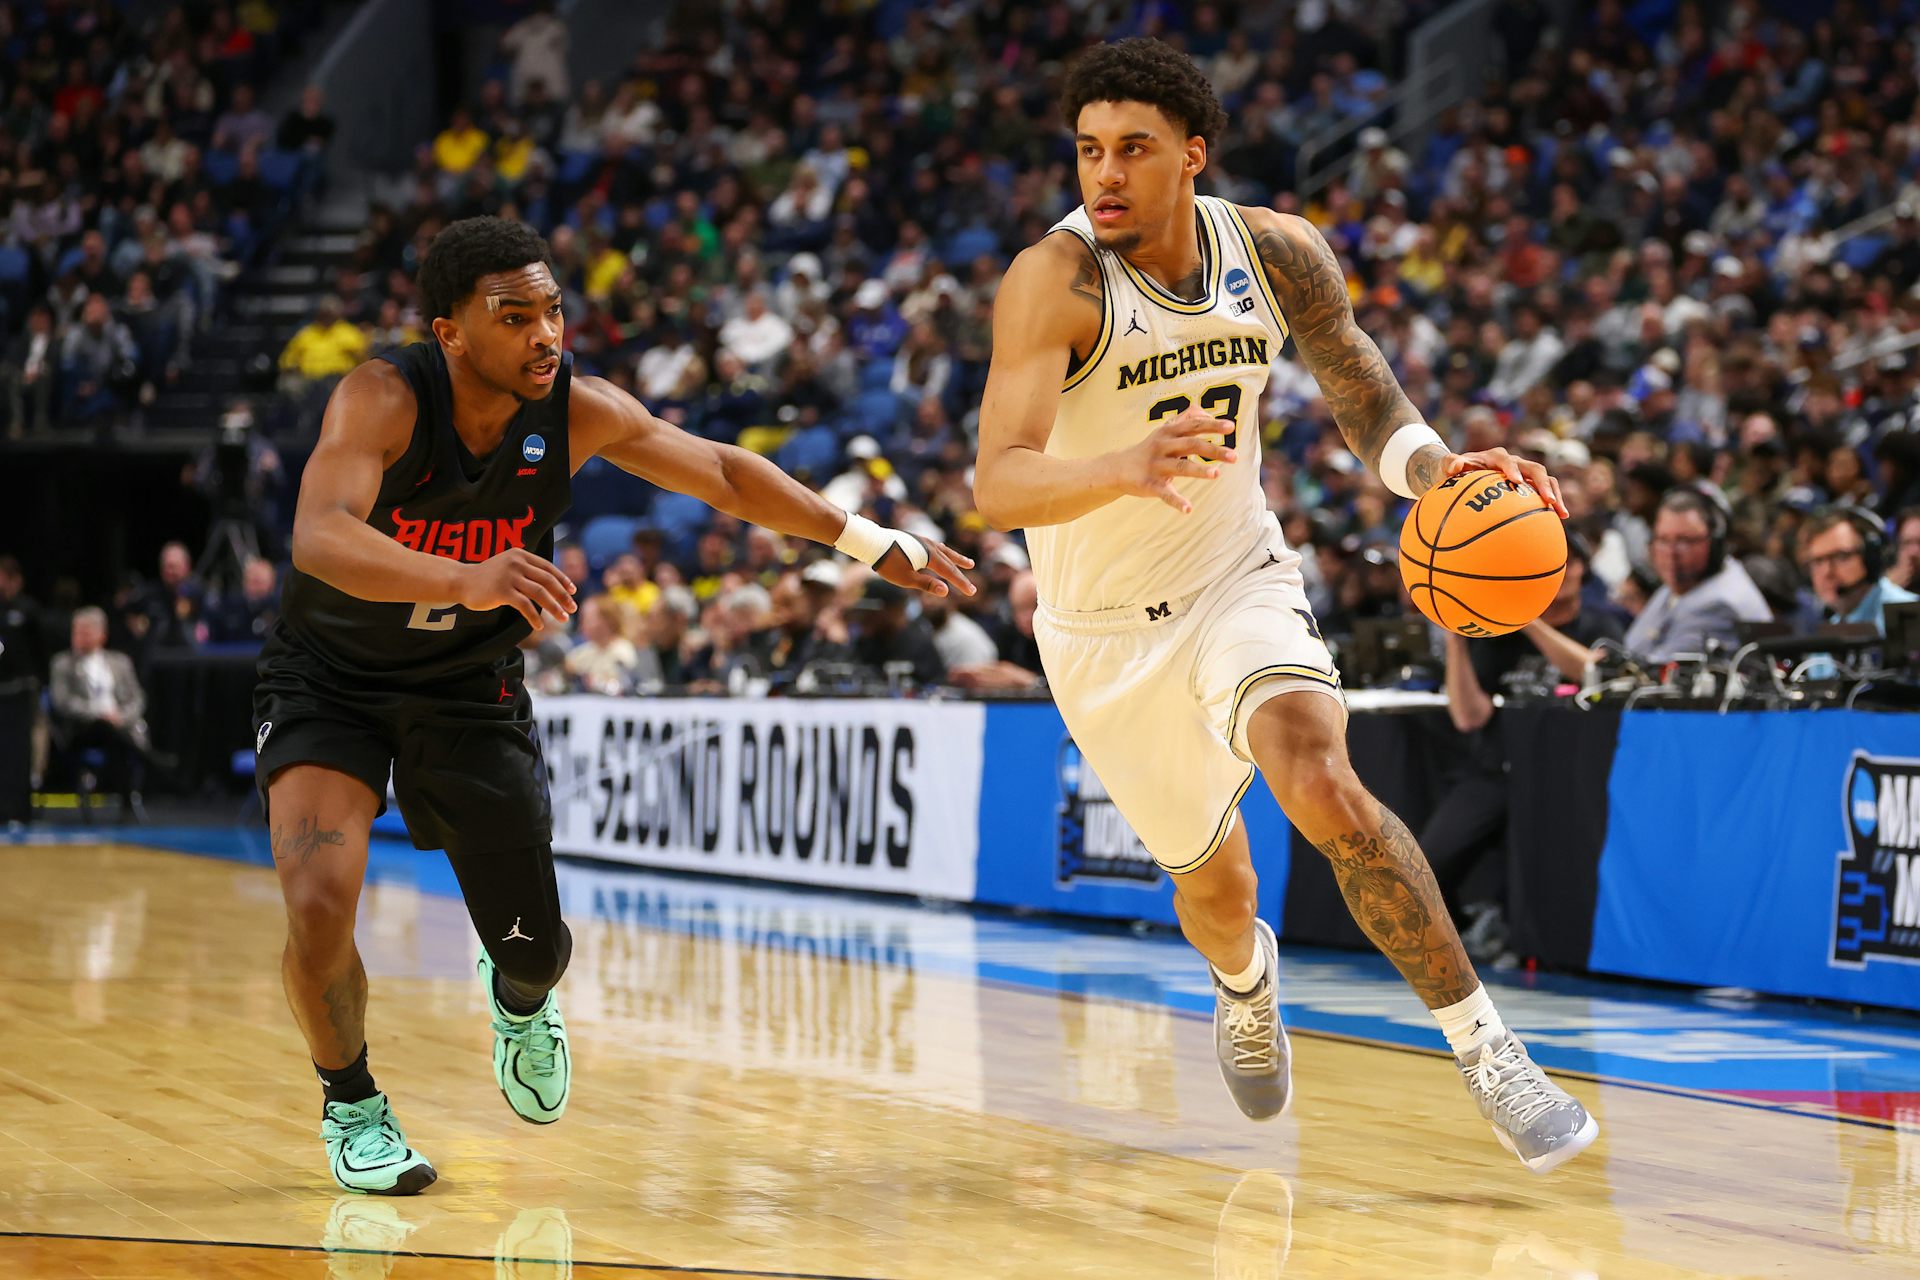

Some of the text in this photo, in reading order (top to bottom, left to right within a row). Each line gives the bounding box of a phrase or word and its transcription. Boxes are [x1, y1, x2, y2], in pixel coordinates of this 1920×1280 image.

[1229, 277, 1249, 291] NCAA
[1116, 336, 1269, 391] MICHIGAN
[391, 504, 535, 563] BISON
[1145, 601, 1172, 622] M
[594, 716, 722, 854] SECOND
[737, 722, 916, 869] ROUNDS
